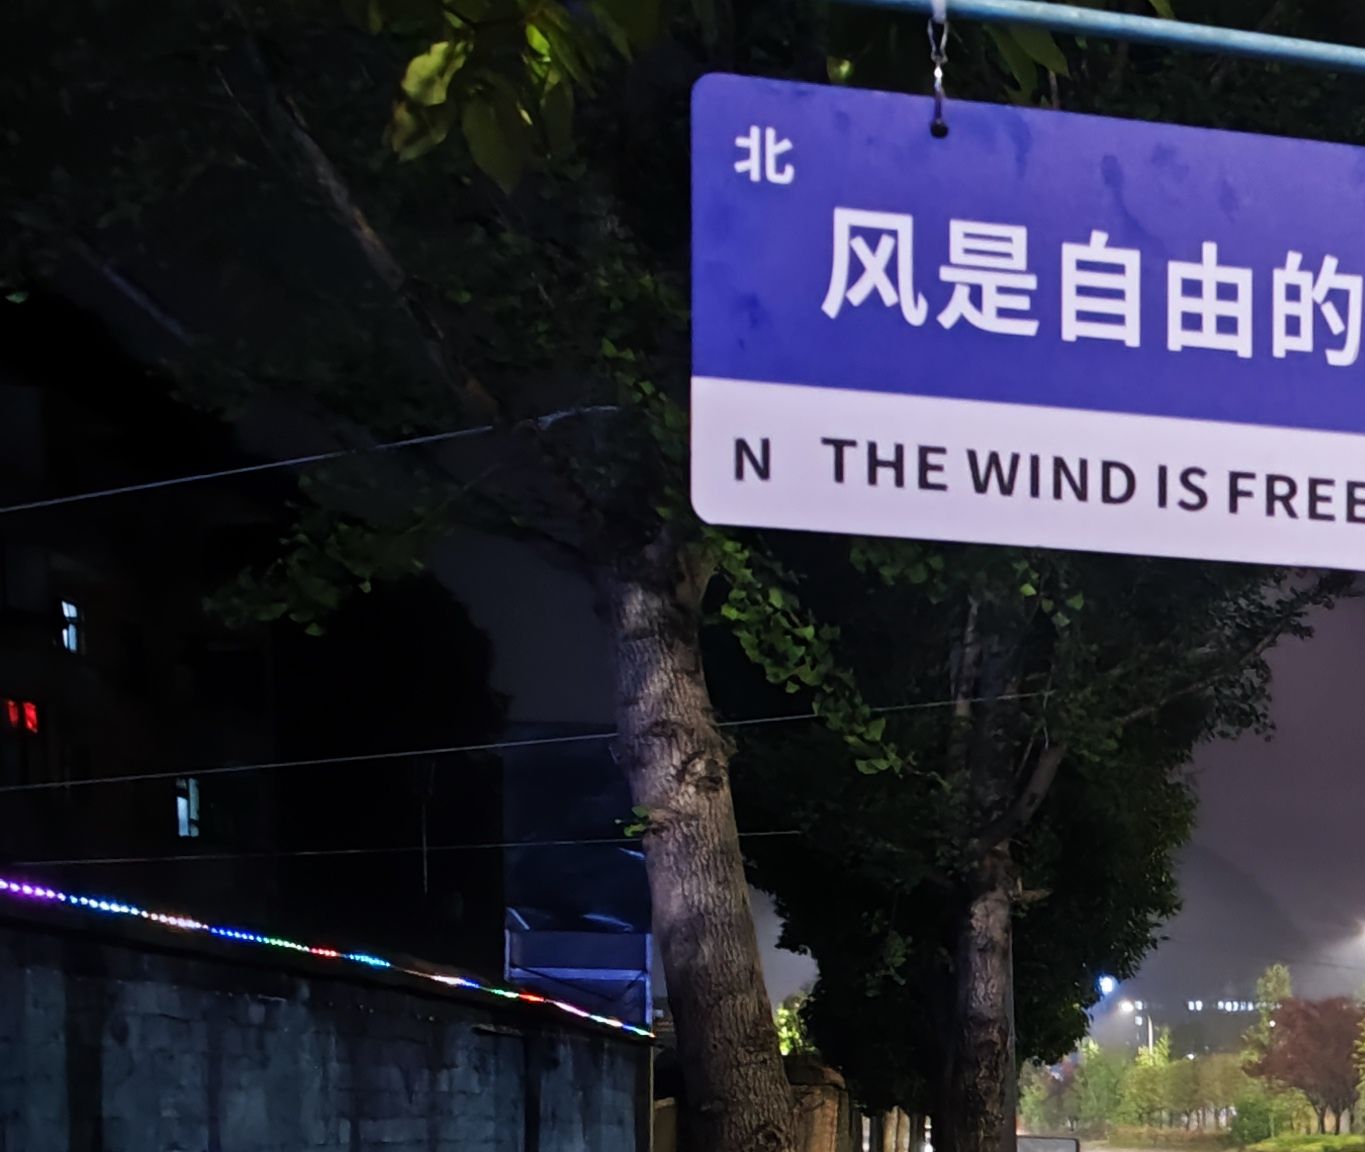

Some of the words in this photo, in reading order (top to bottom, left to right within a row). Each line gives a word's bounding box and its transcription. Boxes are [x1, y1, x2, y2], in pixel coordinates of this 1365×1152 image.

[733, 125, 796, 185] 北
[733, 436, 772, 483] N
[820, 436, 949, 492] THE
[966, 448, 1138, 506] WIND
[1156, 464, 1208, 512] IS
